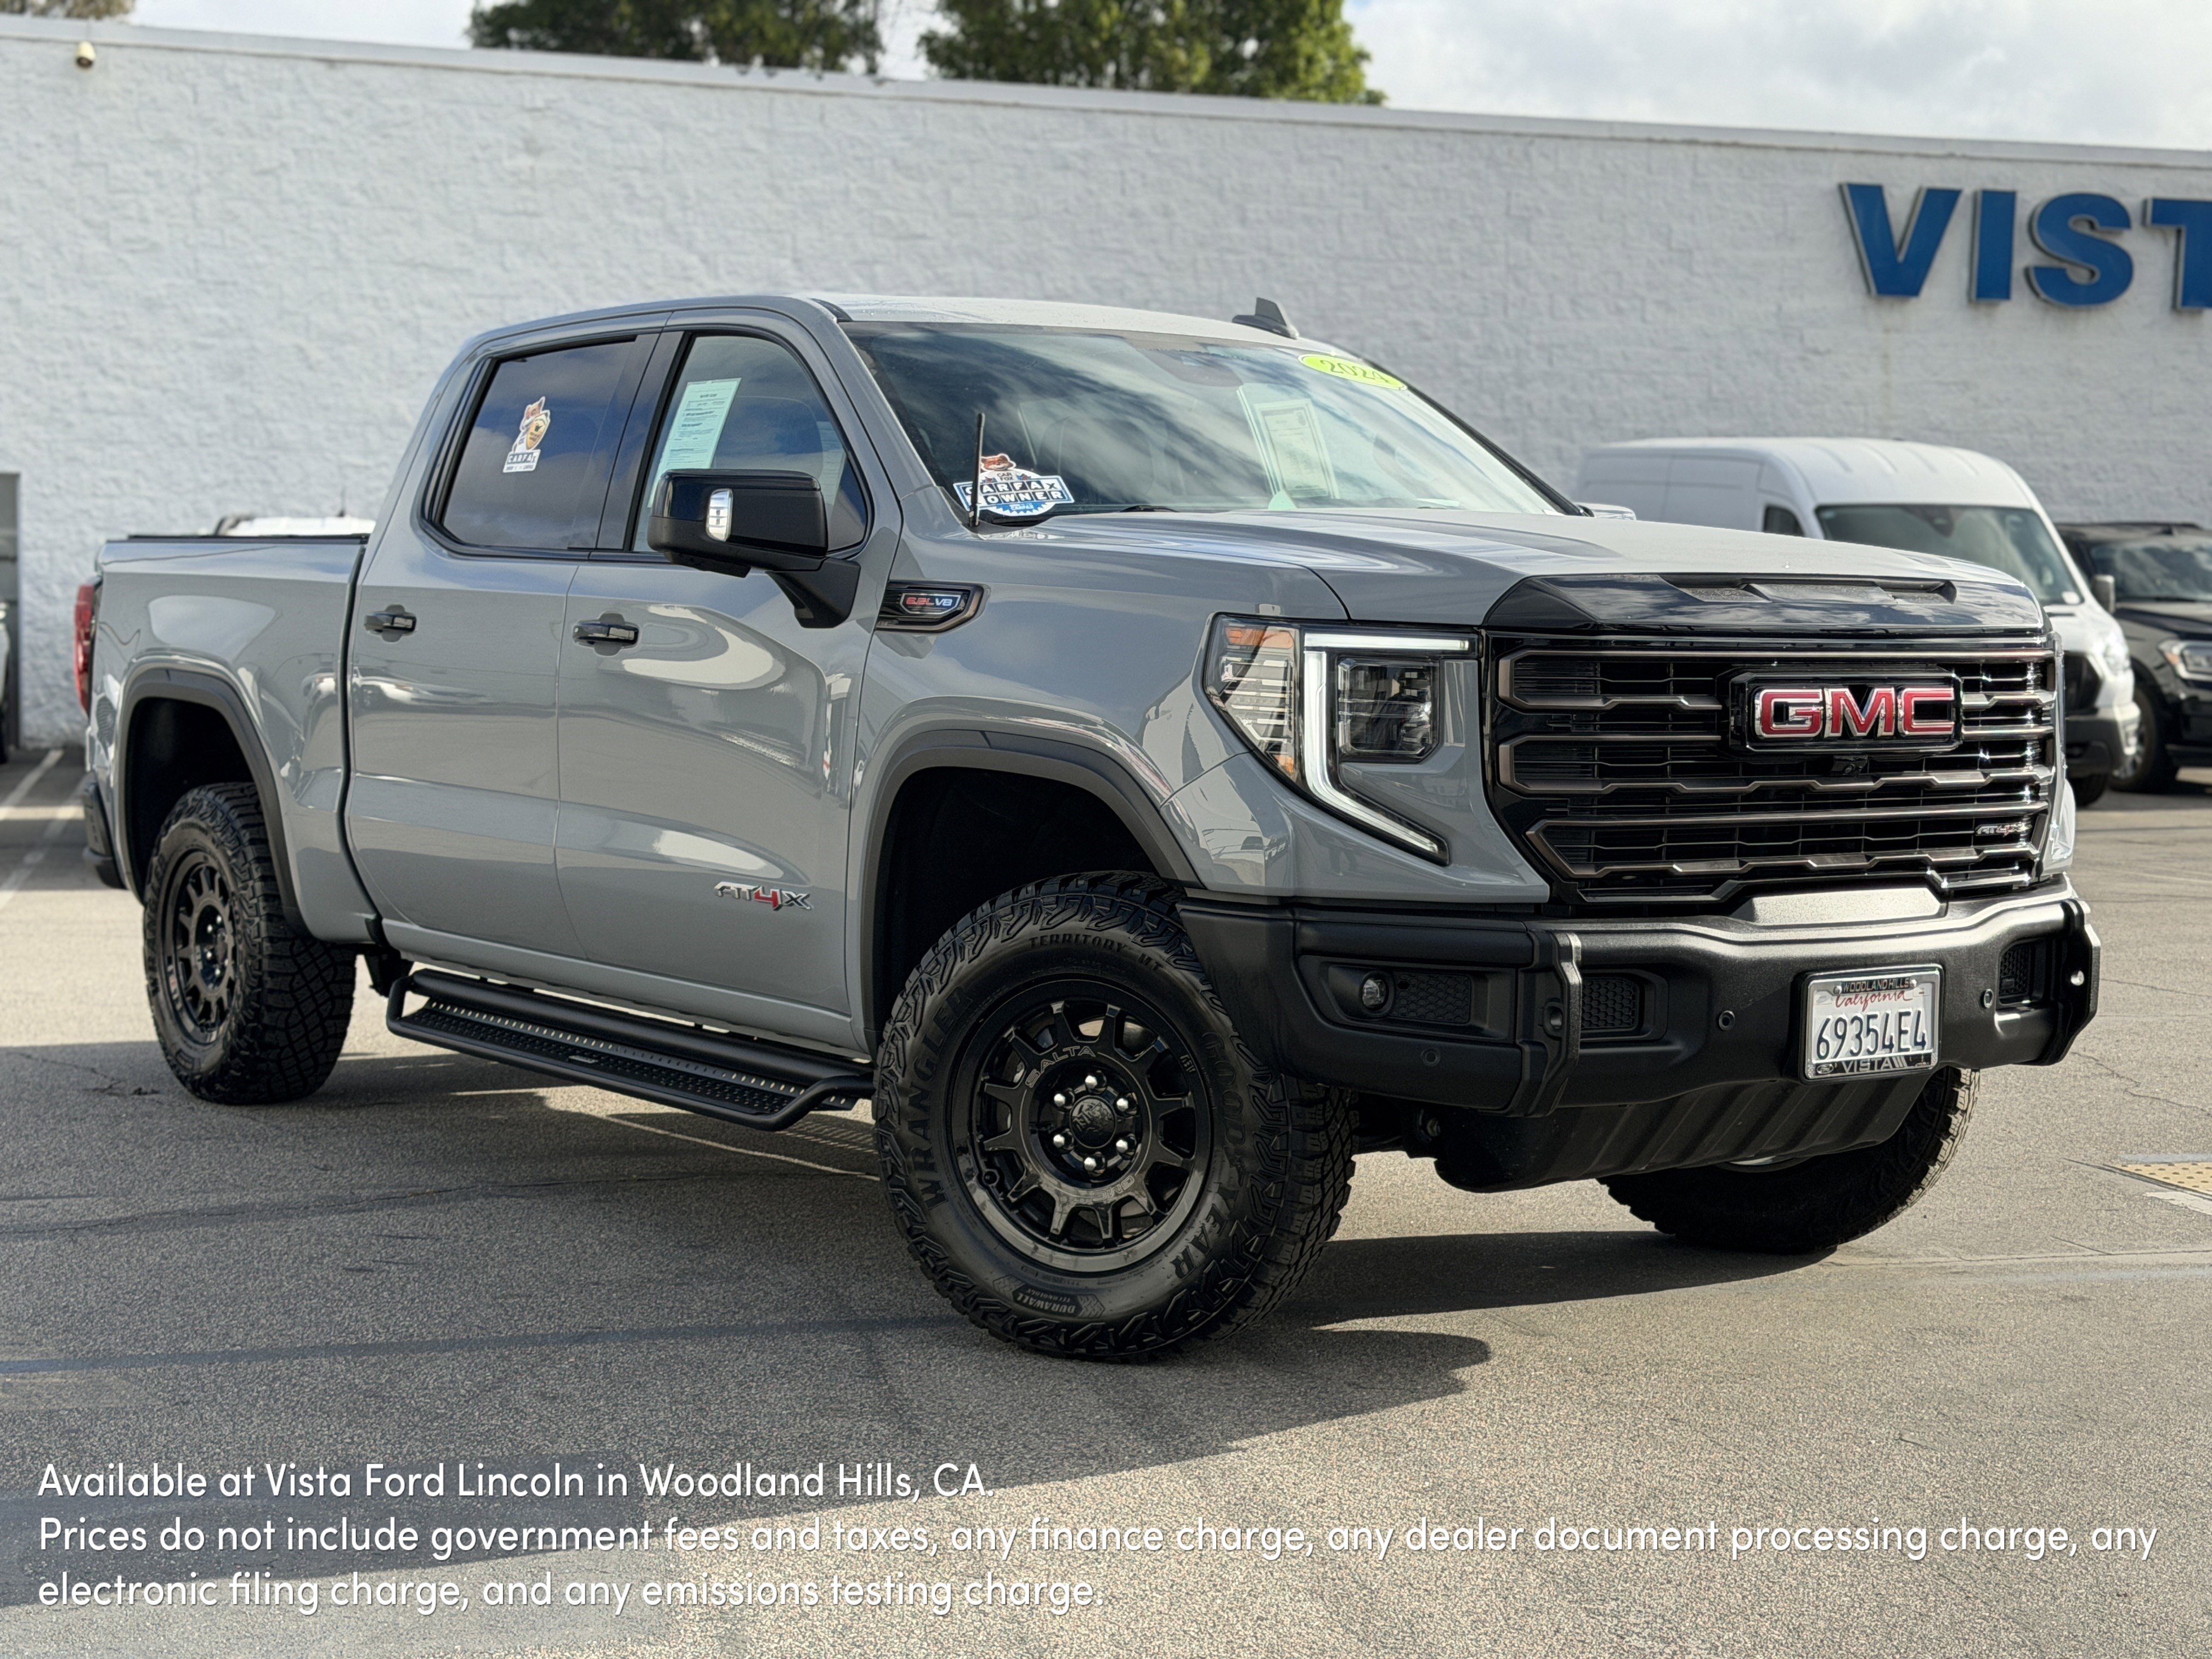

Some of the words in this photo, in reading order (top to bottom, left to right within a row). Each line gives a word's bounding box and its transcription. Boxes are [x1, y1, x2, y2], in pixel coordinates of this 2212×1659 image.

[1319, 359, 1391, 383] 2024
[987, 491, 1063, 504] OWNER
[935, 597, 953, 606] V8
[1754, 687, 1956, 738] GMC
[714, 881, 813, 911] AT4X
[1029, 934, 1128, 953] TERRITORY
[1835, 990, 1914, 1012] California
[1816, 1009, 1927, 1059] 69354E4
[1024, 1045, 1097, 1088] SALTA
[1842, 1056, 1894, 1074] VISTA
[908, 987, 973, 1211] WRANGLER
[1092, 1174, 1135, 1202] GMC
[1016, 1292, 1076, 1313] DURAWALL
